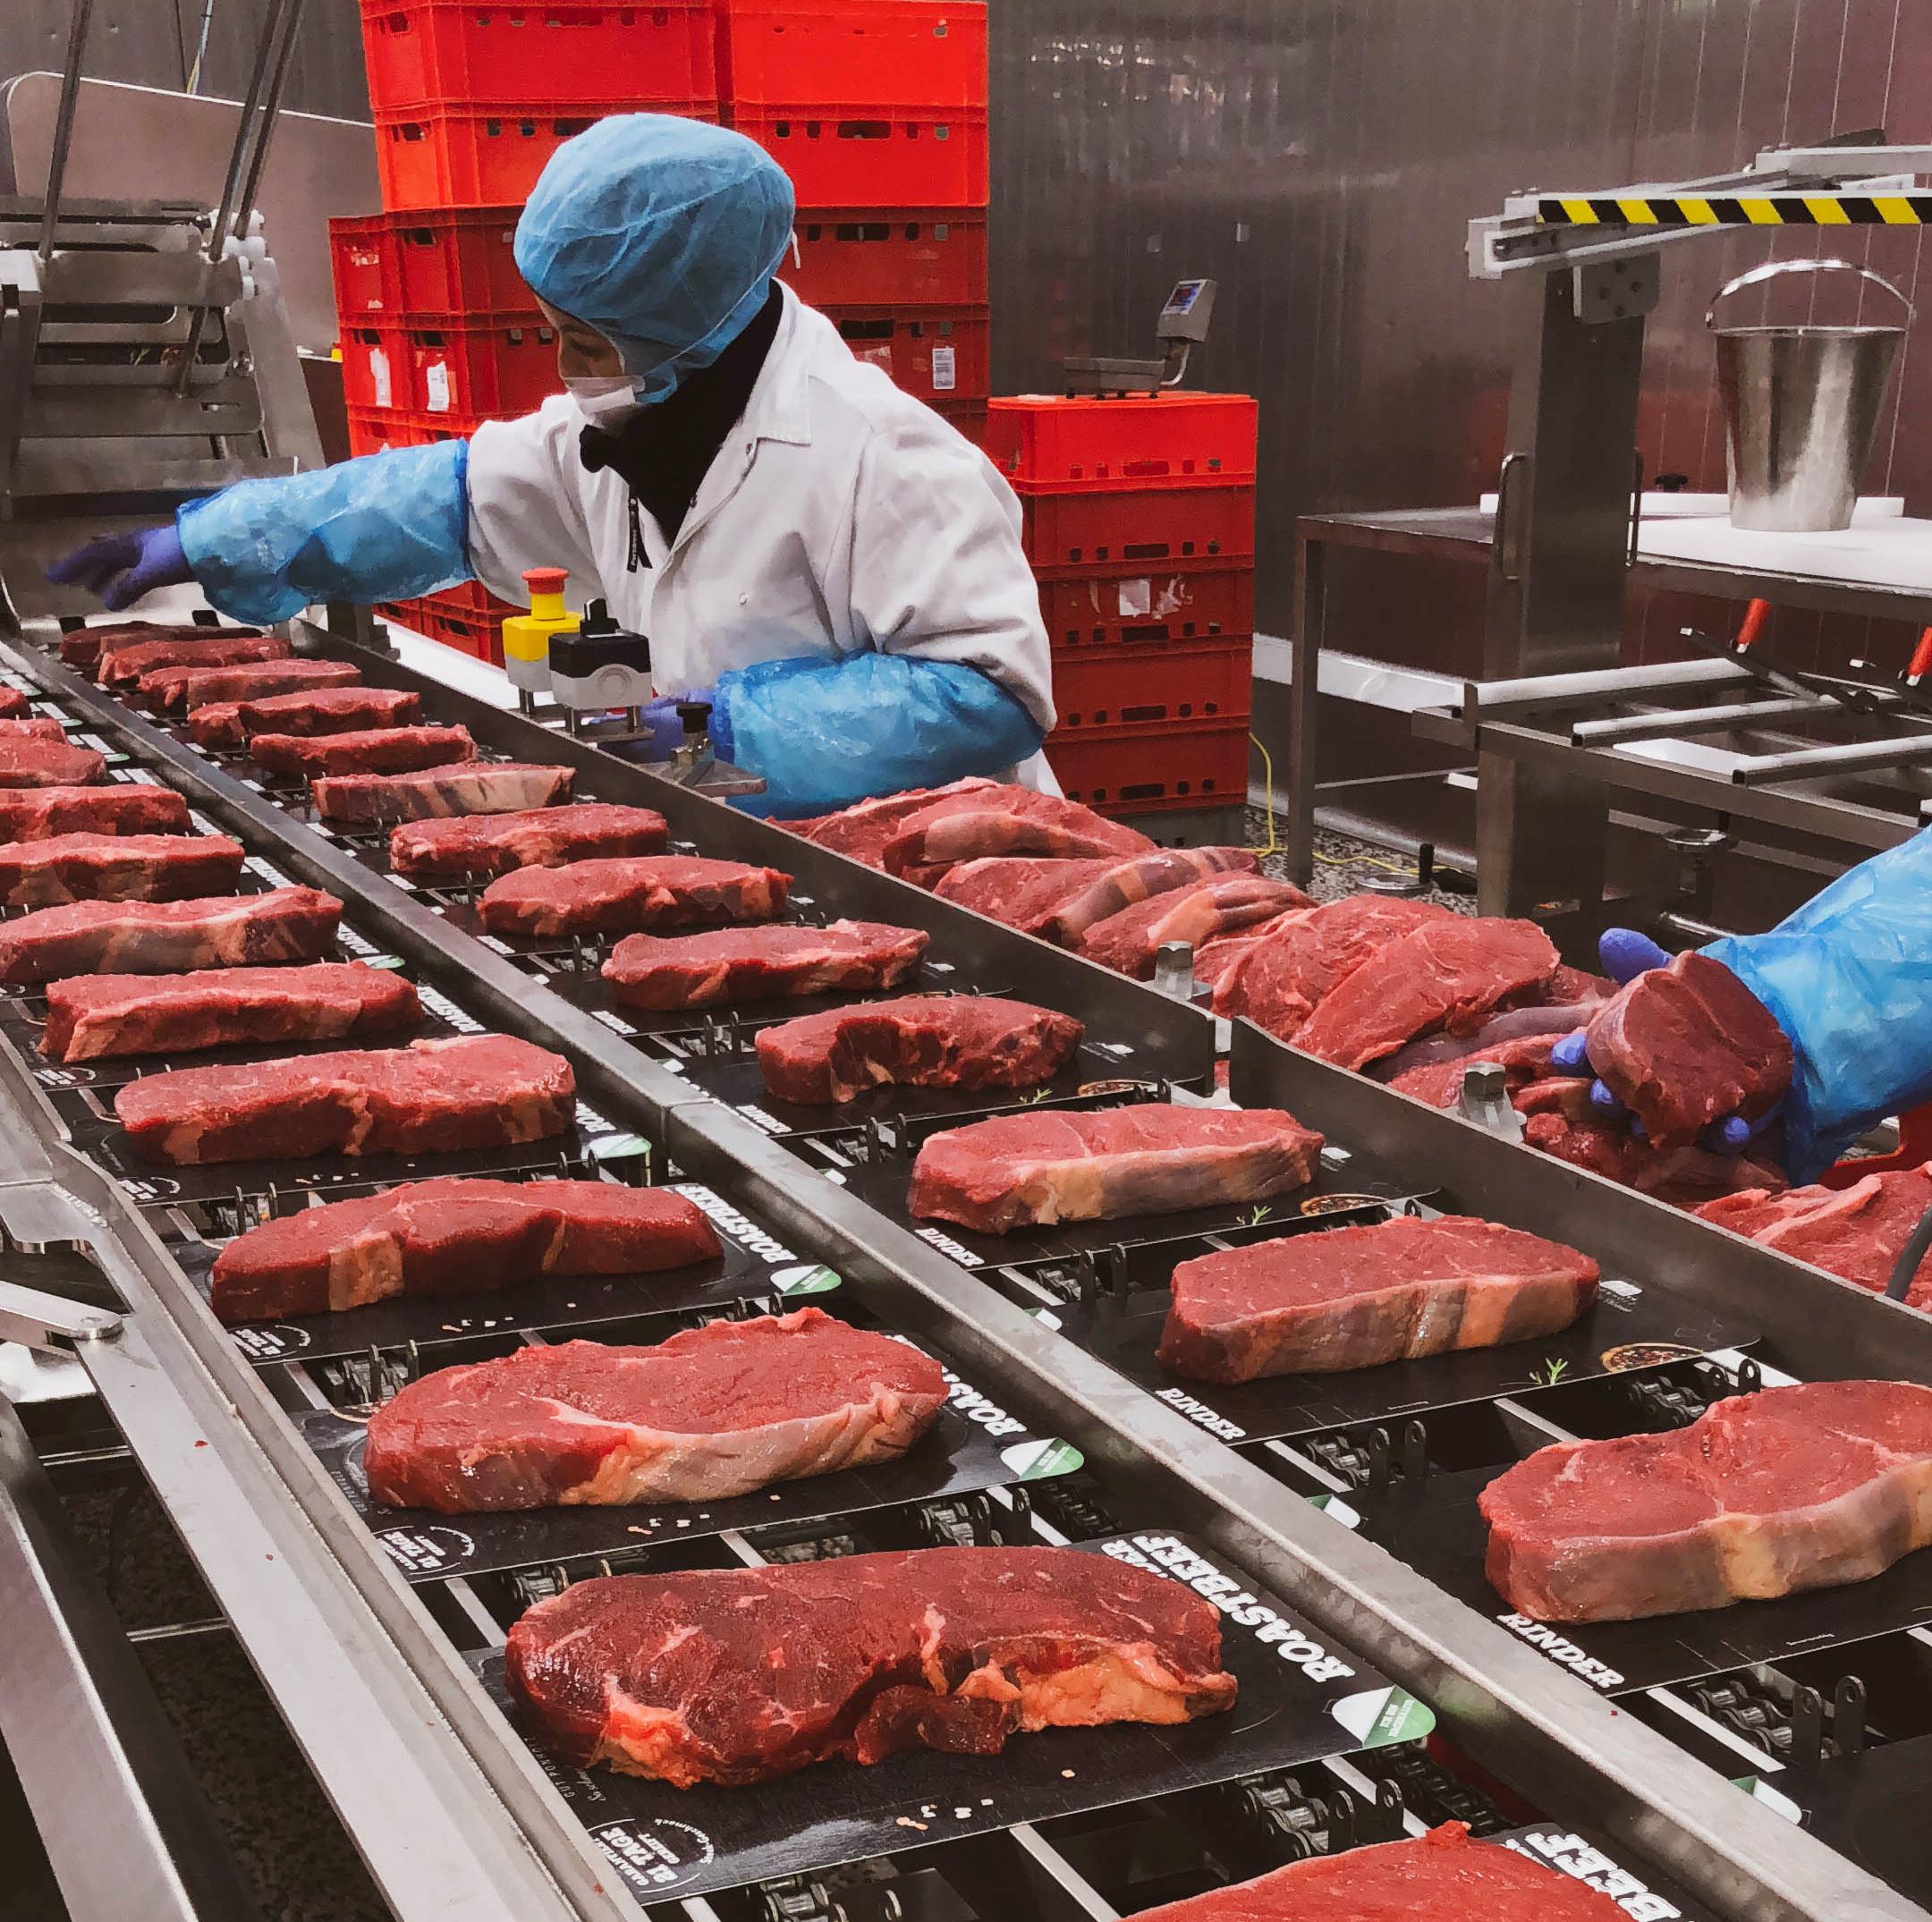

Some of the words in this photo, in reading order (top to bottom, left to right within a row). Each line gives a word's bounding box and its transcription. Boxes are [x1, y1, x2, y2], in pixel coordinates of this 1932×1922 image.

[1155, 1387, 1248, 1441] RINDER
[1132, 1535, 1356, 1683] ROASTBEEF
[1496, 1612, 1625, 1689] RINDER
[599, 1826, 656, 1866] TAGE
[646, 1863, 679, 1884] 21
[1524, 1832, 1682, 1922] BEEF
